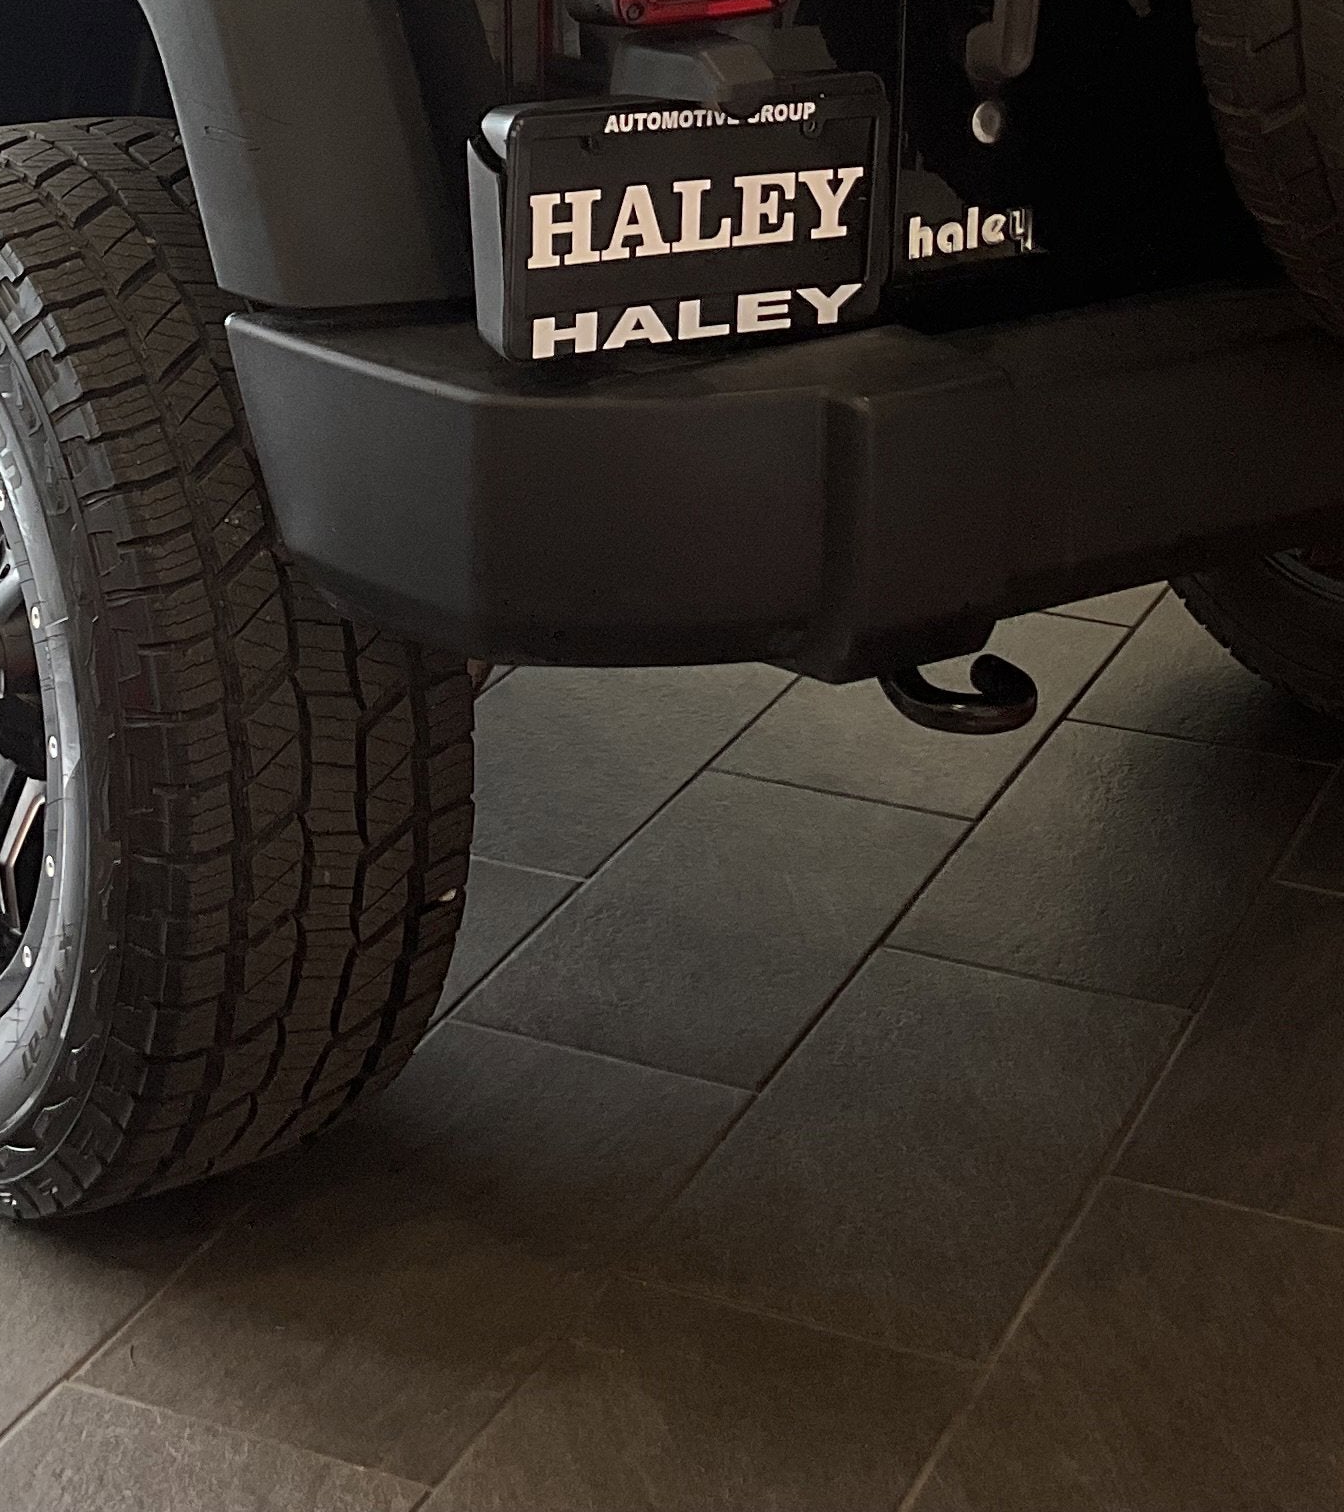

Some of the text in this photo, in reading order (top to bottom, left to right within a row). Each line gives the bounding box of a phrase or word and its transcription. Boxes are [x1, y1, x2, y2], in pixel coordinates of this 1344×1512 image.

[527, 166, 864, 270] HALEY
[908, 205, 1033, 261] haley
[532, 283, 862, 360] HALEY
